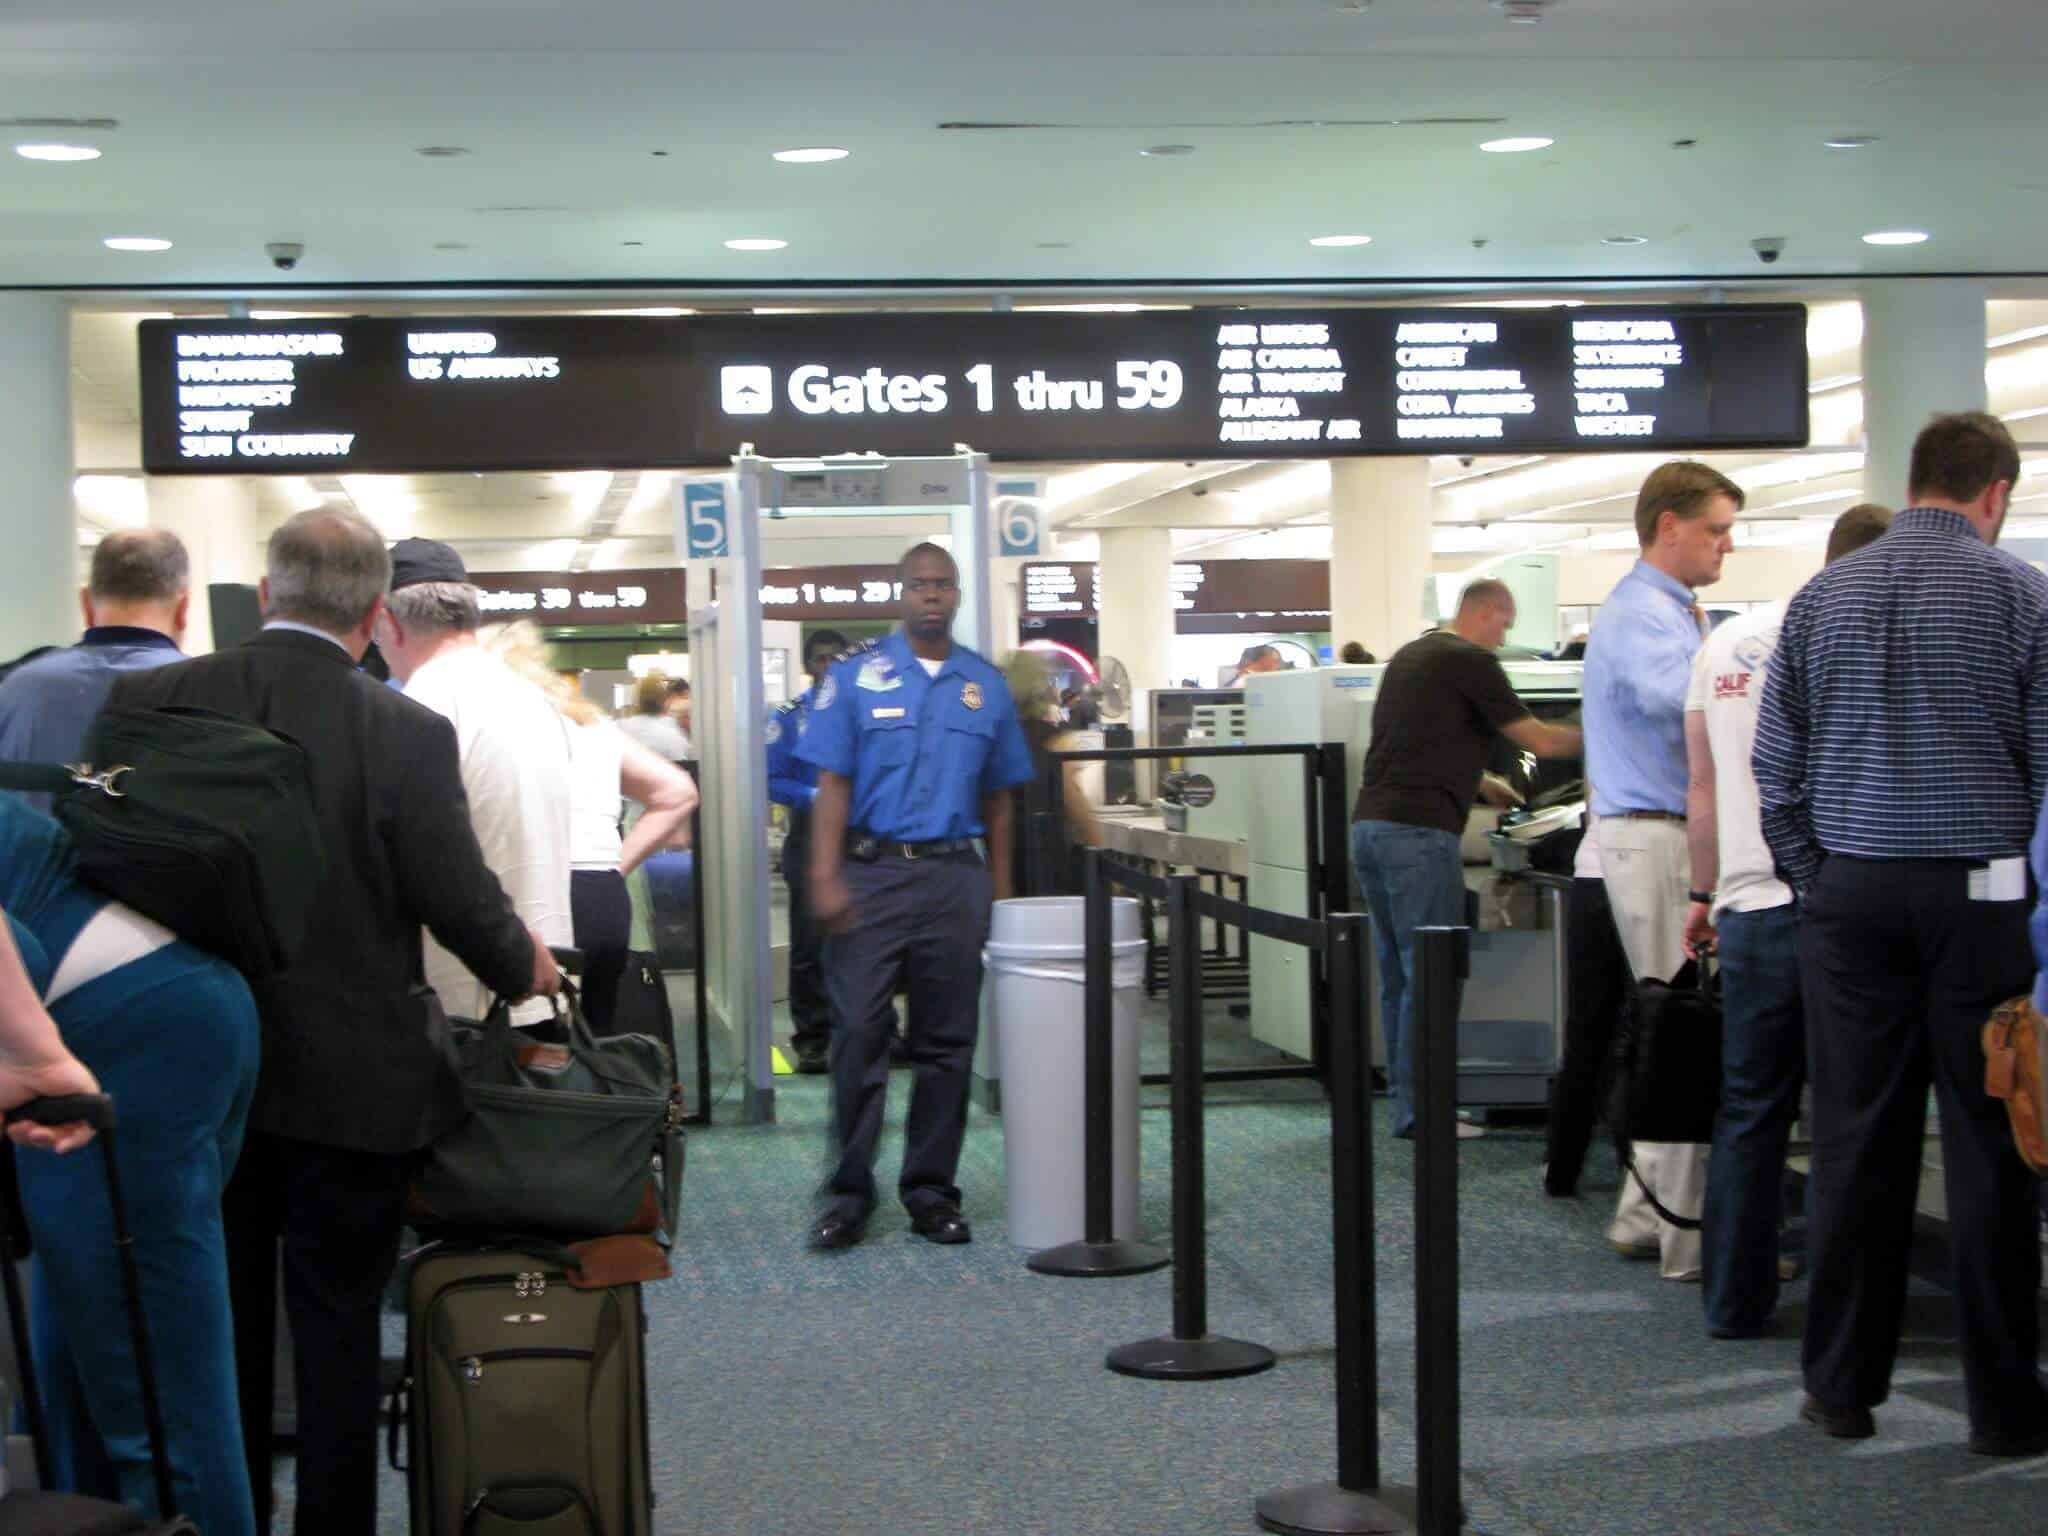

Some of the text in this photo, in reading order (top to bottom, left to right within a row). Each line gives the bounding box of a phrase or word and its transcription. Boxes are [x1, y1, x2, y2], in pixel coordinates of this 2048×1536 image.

[407, 332, 496, 355] UNITED
[407, 357, 561, 380] US AIRWAYS
[788, 360, 1184, 414] Gates 1 thru 59
[1218, 396, 1301, 418] ALASKA
[1325, 419, 1362, 440] AIR
[180, 434, 355, 457] SUN COUNTRY
[690, 499, 728, 549] 5
[1003, 500, 1036, 548] 6
